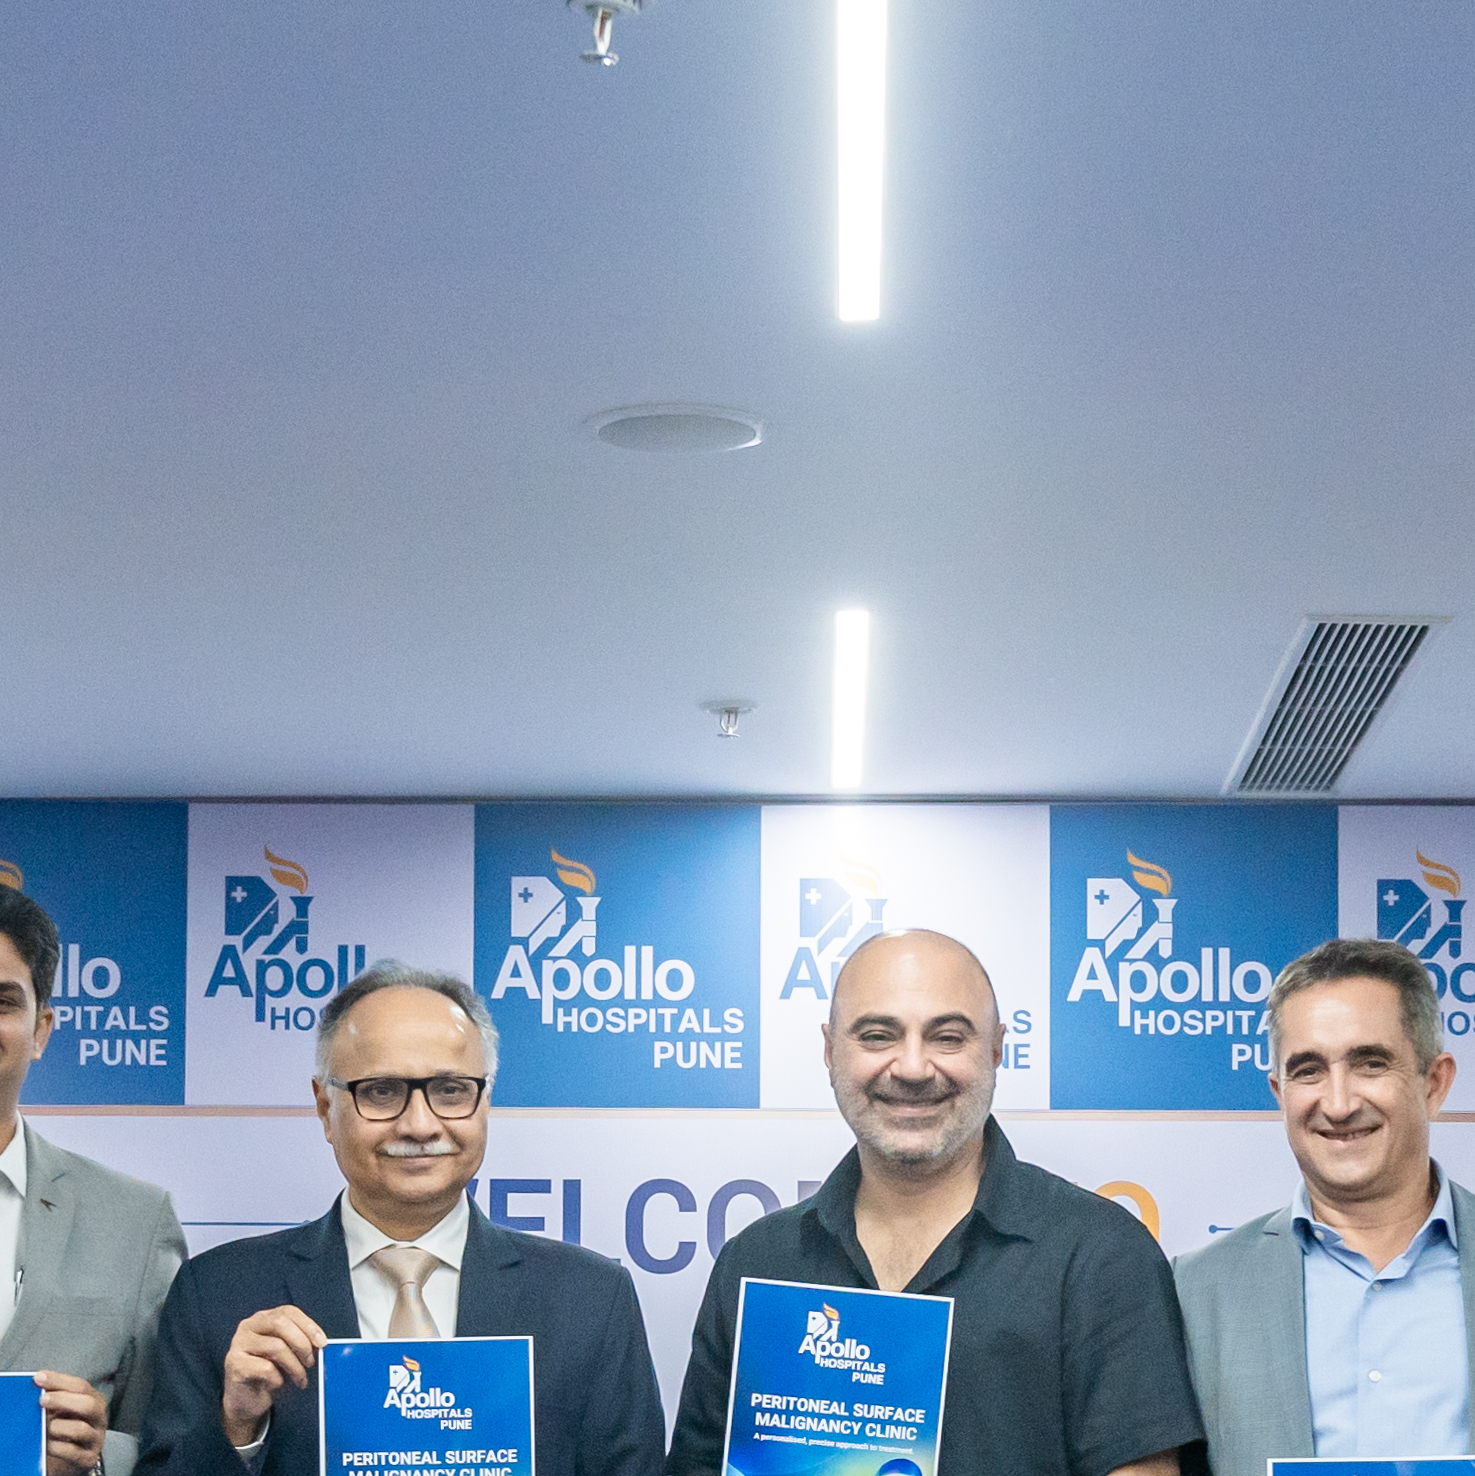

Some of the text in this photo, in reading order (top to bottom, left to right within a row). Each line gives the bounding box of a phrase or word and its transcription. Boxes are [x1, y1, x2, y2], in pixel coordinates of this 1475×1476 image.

[204, 944, 366, 1023] Apoll
[491, 945, 696, 1025] Apollo
[1066, 946, 1273, 1027] Apollo
[54, 1004, 170, 1031] PITALS
[556, 1007, 745, 1034] HOSPITALS
[79, 1038, 168, 1066] PUNE
[653, 1041, 743, 1069] PUNE
[798, 1334, 870, 1364] Apollo
[820, 1358, 886, 1373] HOSPITALS
[851, 1372, 884, 1385] PUNE
[383, 1387, 455, 1416] Apollo
[406, 1407, 473, 1419] HOSPITALS
[750, 1393, 926, 1423] PERITONEAL SURFACE
[440, 1419, 472, 1430] PUNE
[754, 1411, 918, 1441] MALIGNANCY CLINIC
[342, 1449, 518, 1466] PERITONEAL SURFACE
